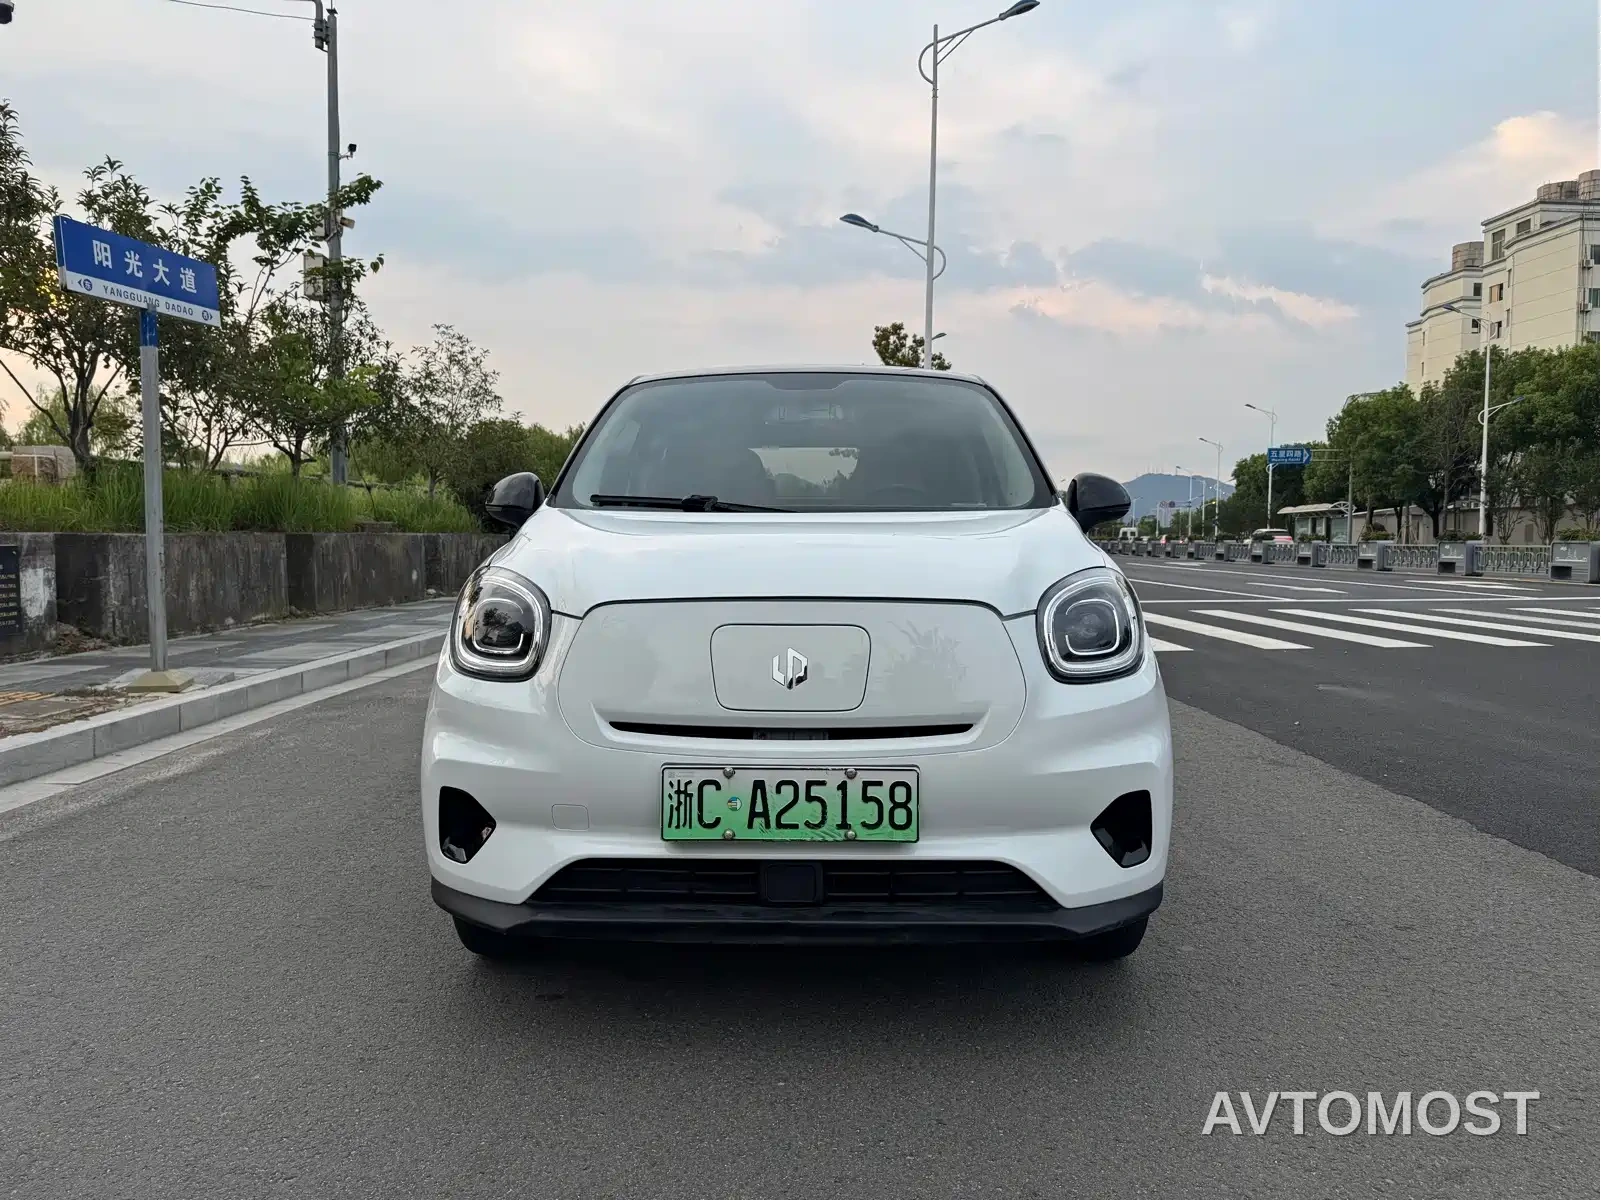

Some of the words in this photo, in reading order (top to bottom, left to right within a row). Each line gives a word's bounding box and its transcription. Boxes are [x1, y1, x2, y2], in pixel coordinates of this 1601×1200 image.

[92, 239, 197, 294] 阳光大道
[103, 285, 160, 308] YANGGUANG
[165, 301, 194, 316] DADAO
